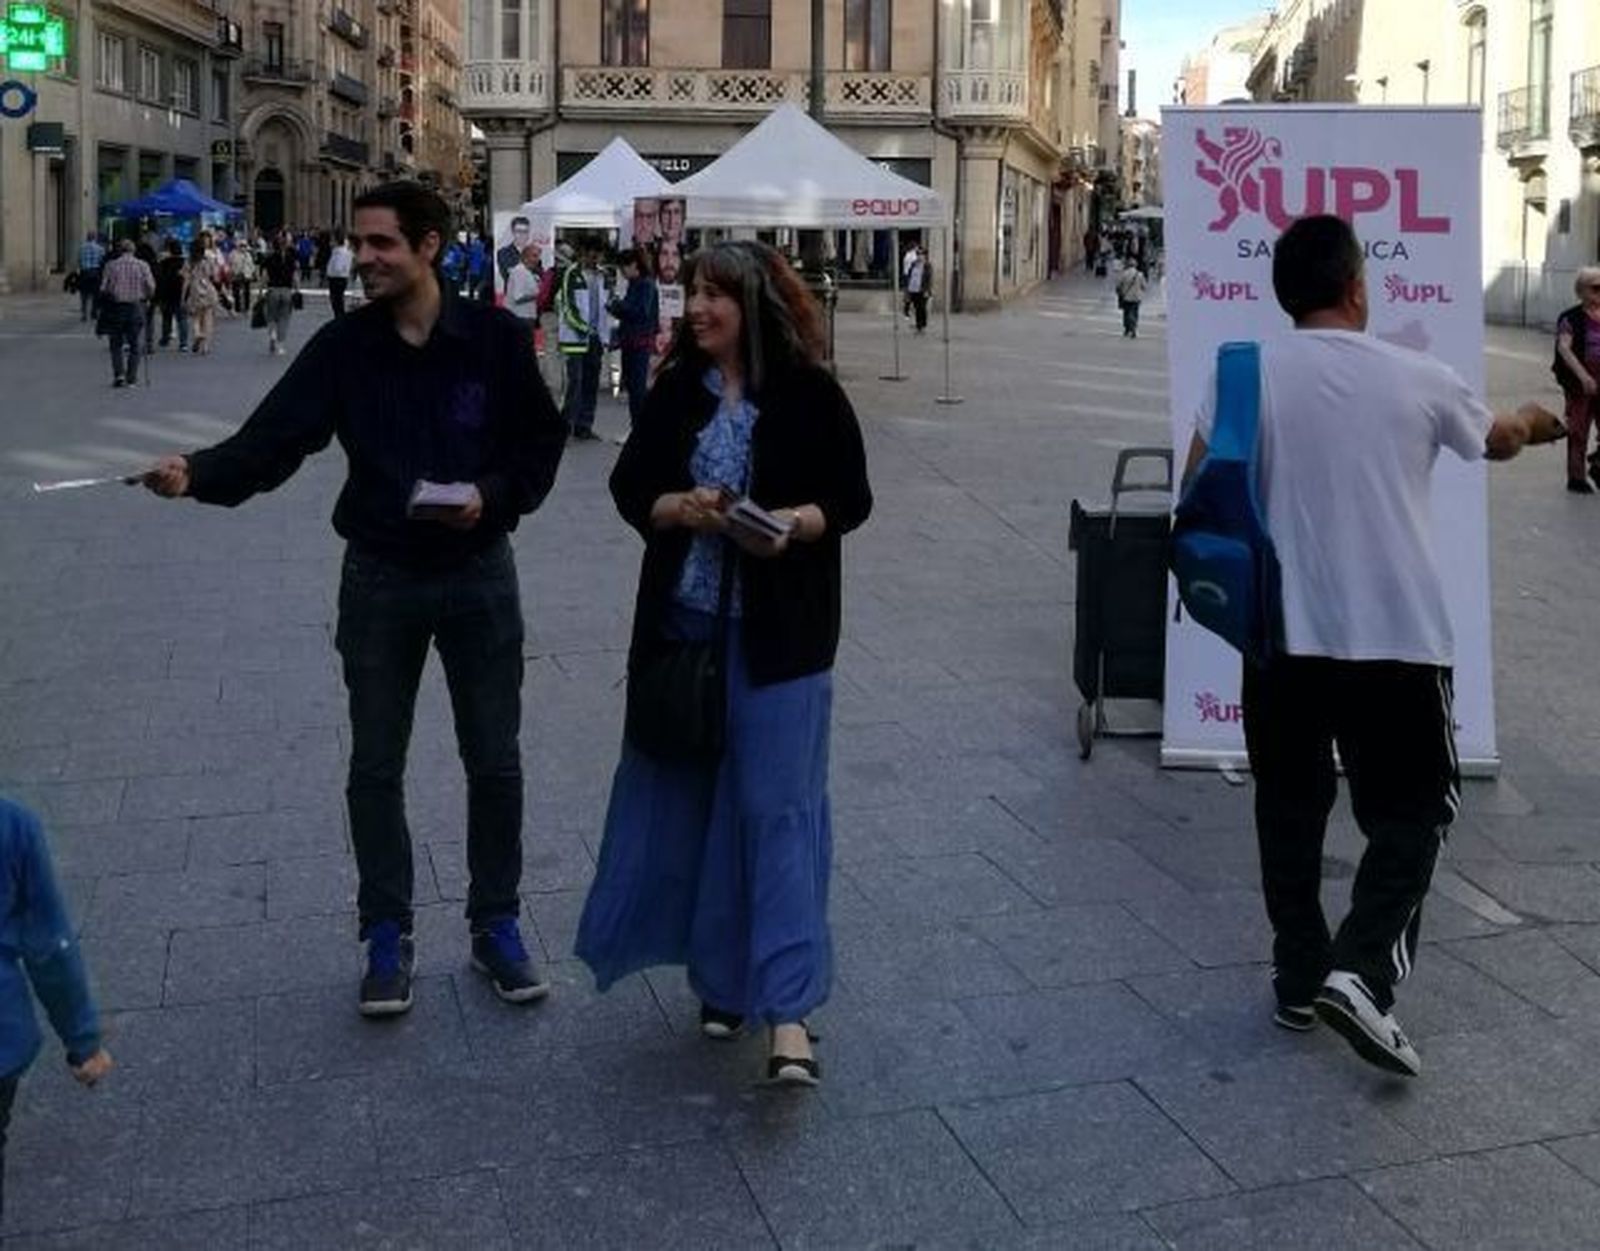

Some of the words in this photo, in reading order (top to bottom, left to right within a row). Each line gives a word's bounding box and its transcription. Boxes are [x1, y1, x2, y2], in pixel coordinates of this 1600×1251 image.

[1258, 166, 1451, 233] UPL
[1207, 282, 1259, 301] UPL
[1400, 284, 1454, 303] UPL
